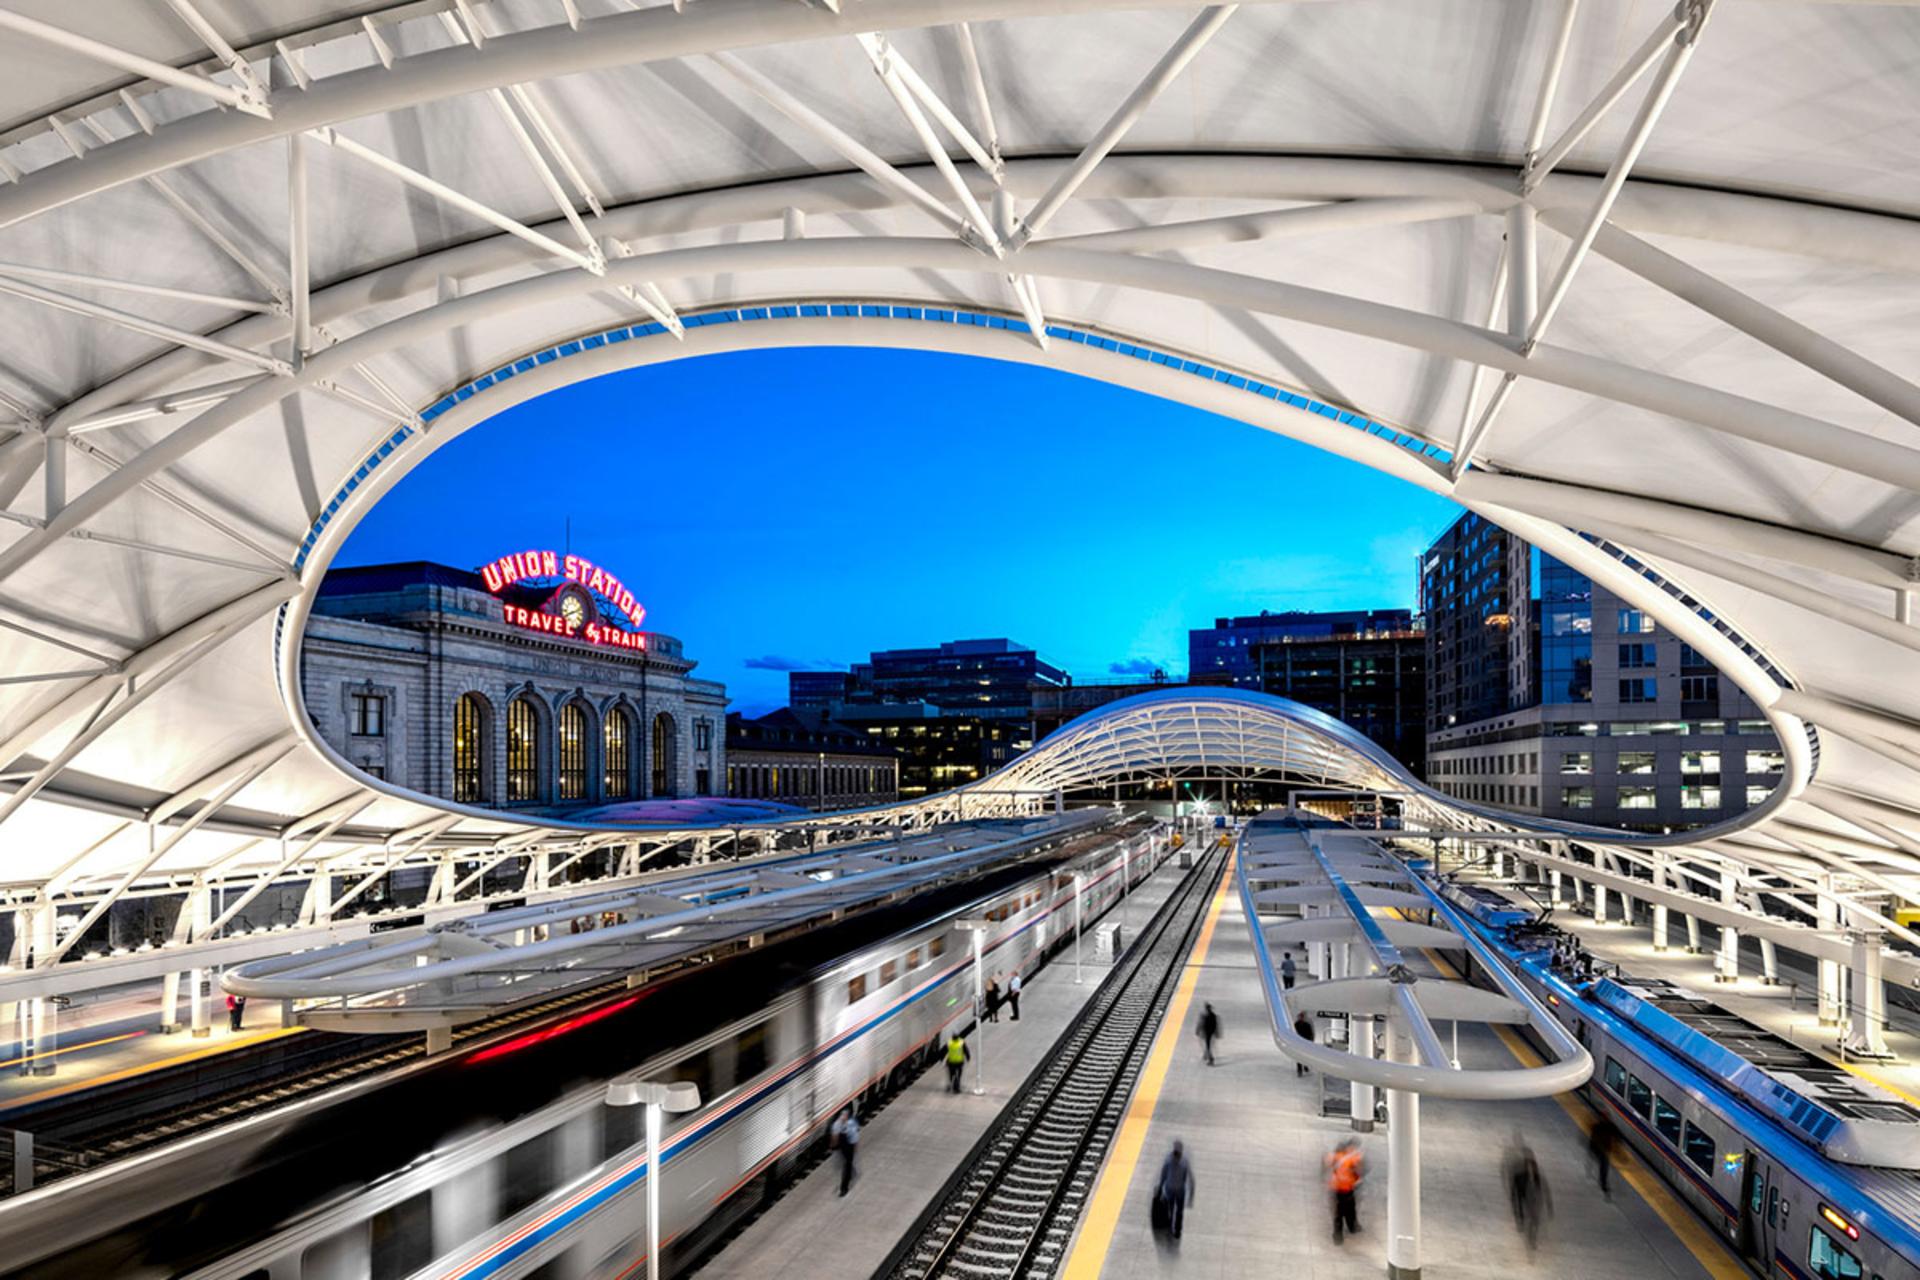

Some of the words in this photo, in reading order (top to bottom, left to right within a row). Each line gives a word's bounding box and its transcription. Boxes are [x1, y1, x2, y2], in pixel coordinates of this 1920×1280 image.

[482, 551, 557, 591] UNION
[564, 555, 646, 627] STATION
[504, 605, 575, 635] TRAVEL
[586, 622, 600, 644] by
[602, 627, 645, 649] TRAIN
